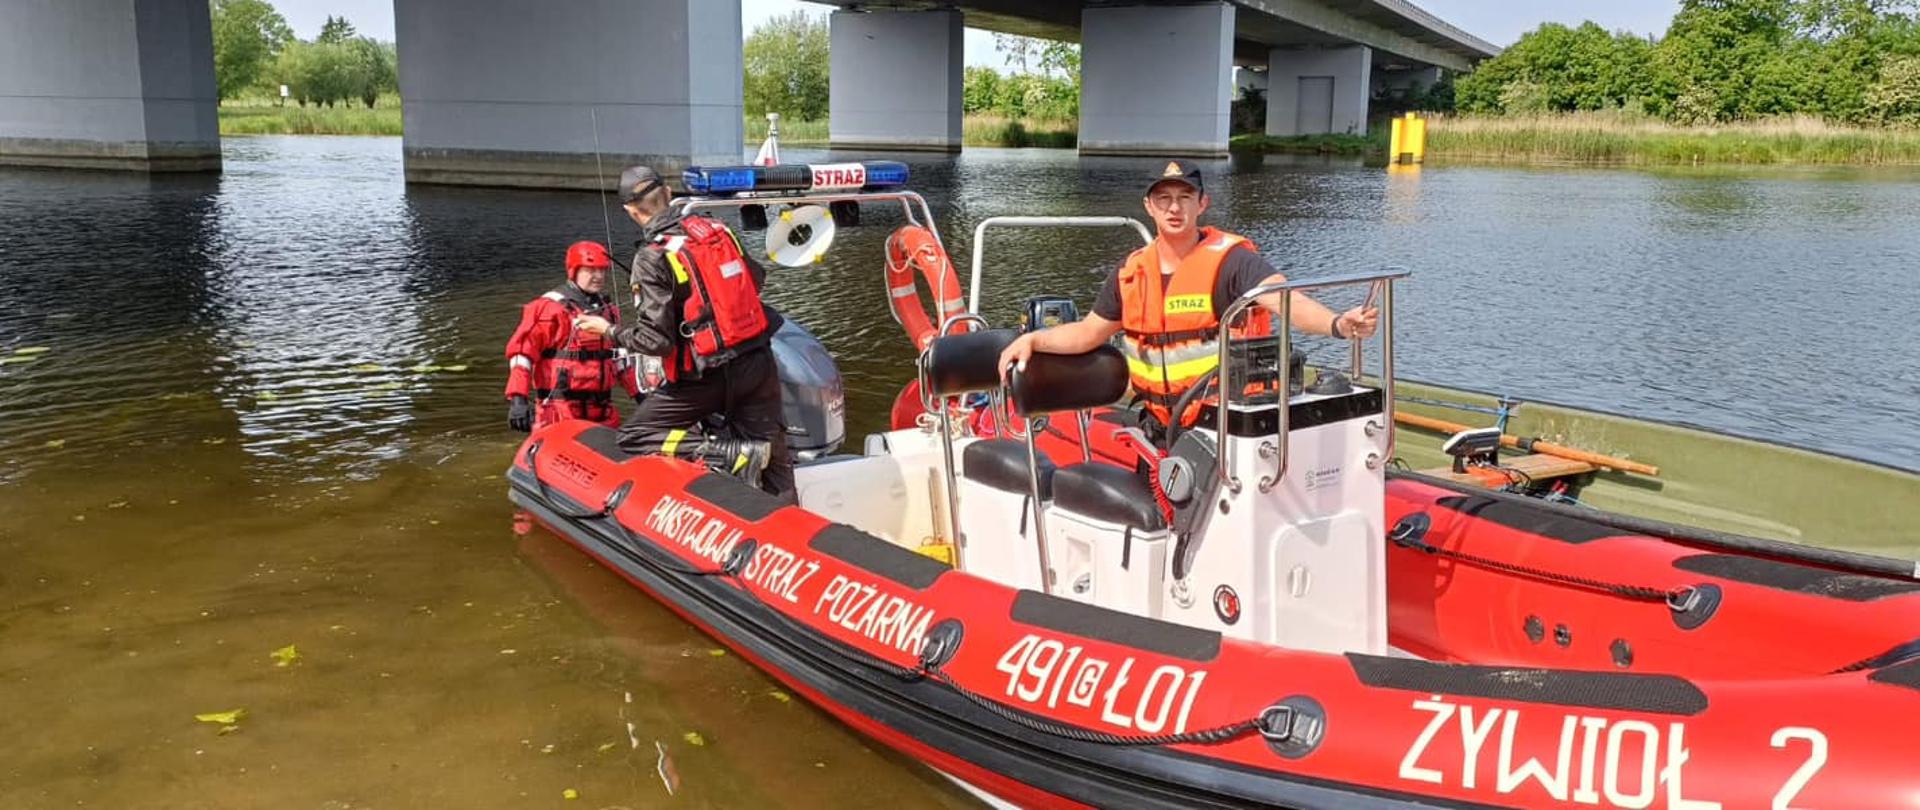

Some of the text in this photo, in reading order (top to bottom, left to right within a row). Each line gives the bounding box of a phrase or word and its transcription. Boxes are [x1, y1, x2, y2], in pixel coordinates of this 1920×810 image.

[645, 495, 935, 656] PAŃSTWOWA STRAŻ POŻARNA
[1399, 695, 1829, 810] ŻYWIOŁ 2
